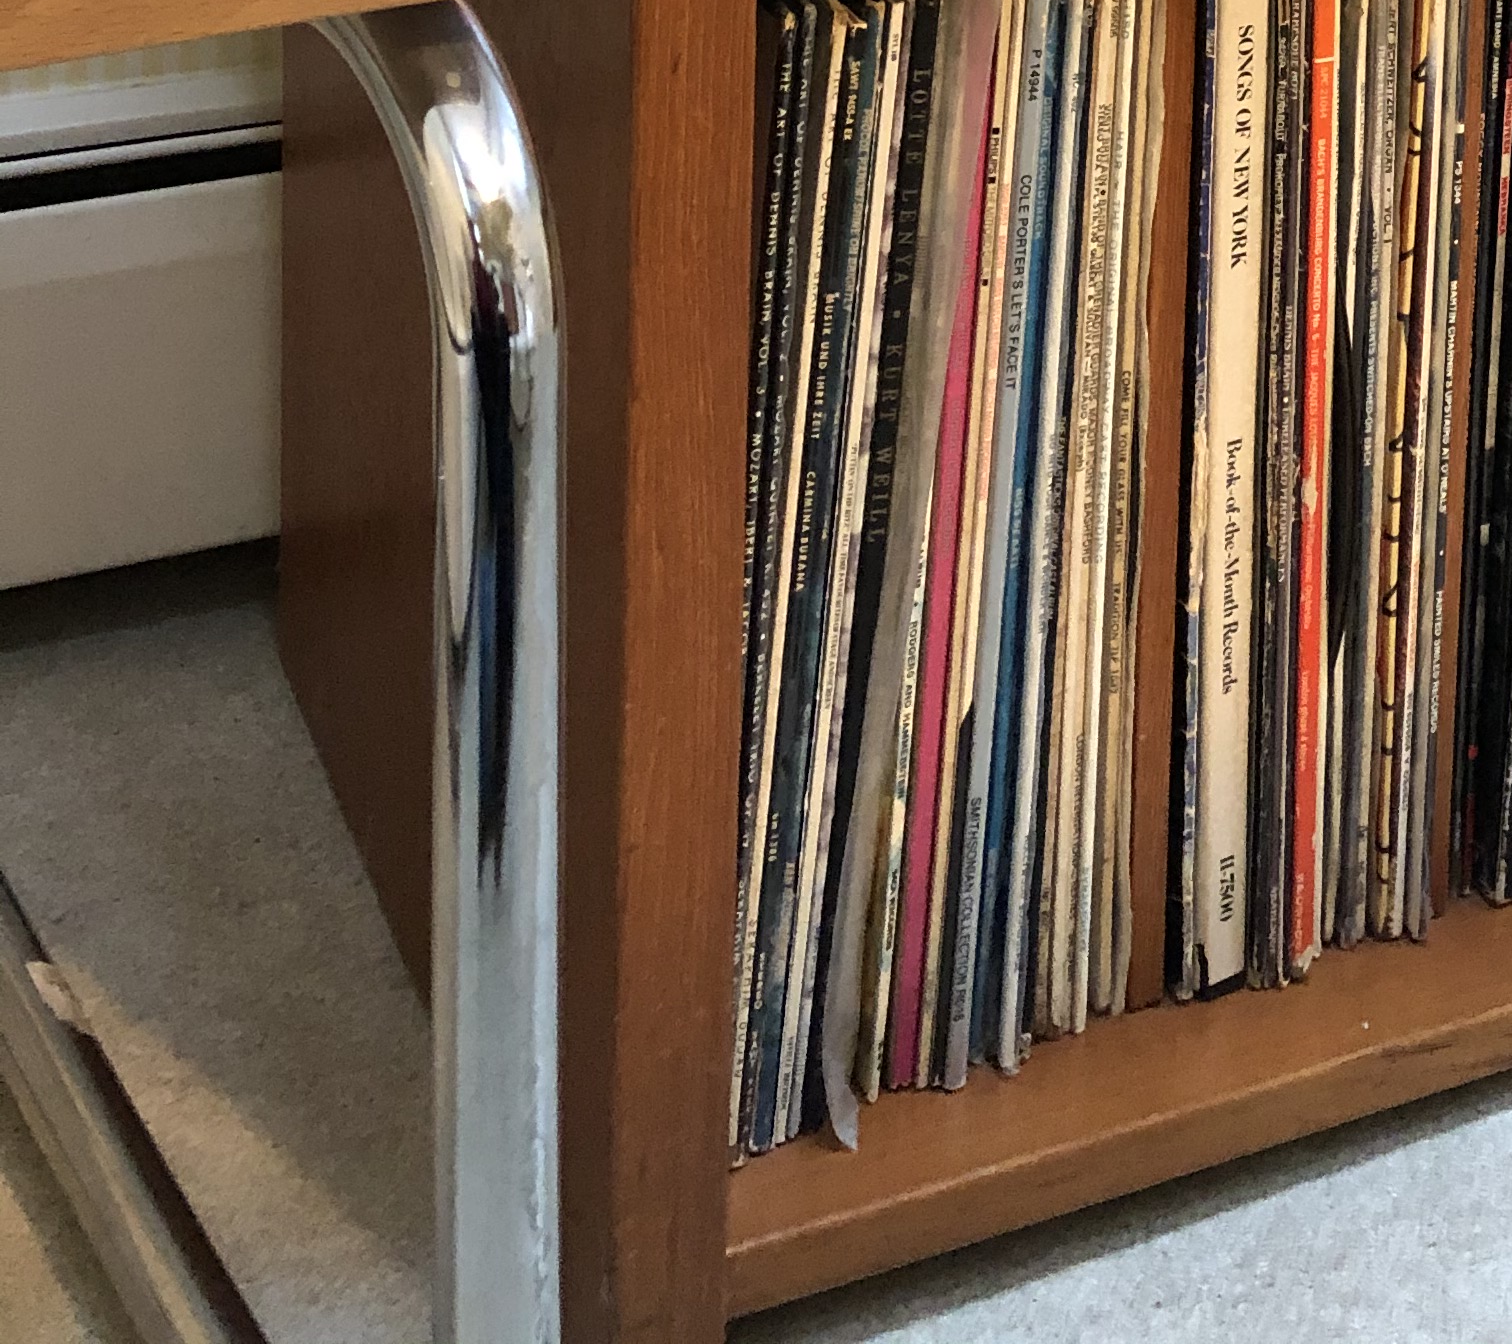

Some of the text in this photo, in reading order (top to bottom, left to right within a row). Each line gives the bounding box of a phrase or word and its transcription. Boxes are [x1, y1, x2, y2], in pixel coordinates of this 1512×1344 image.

[1028, 64, 1041, 102] 14944
[1032, 49, 1042, 58] P
[1236, 24, 1254, 102] SONGS
[1234, 108, 1250, 138] OF
[1018, 174, 1032, 213] COLE
[1232, 148, 1249, 198] NEW
[1012, 218, 1029, 289] PORTER'S
[1230, 204, 1248, 269] YORK
[868, 69, 931, 544] LOTTE LENYA KURT WEILL
[1008, 294, 1022, 334] LET'S
[1004, 378, 1016, 390] IT
[1006, 337, 1020, 373] FACE
[794, 294, 835, 592] MUSIK UND IHRE ZEIT CARMINA BURANA
[1222, 438, 1244, 618] Book-of-the-Month
[1221, 621, 1239, 695] Records
[898, 621, 918, 800] RODGERS AND HAMMERSTEIN
[961, 797, 982, 894] SMITHSONIAN
[954, 898, 974, 986] COLLECTION
